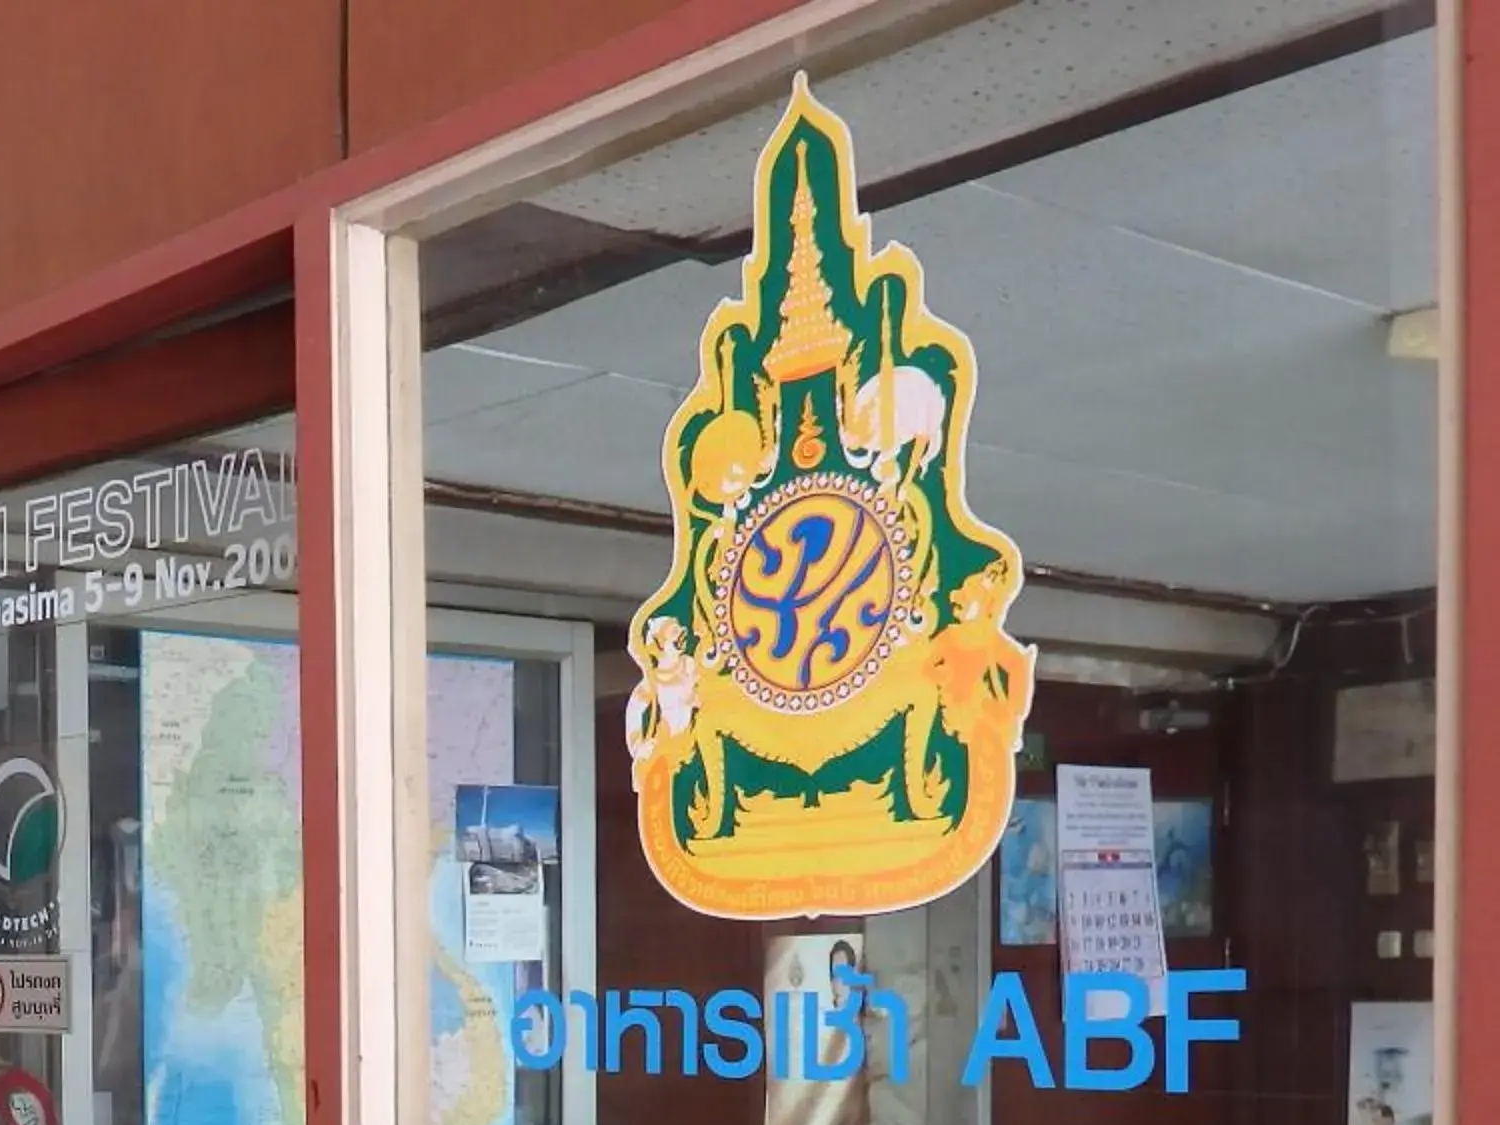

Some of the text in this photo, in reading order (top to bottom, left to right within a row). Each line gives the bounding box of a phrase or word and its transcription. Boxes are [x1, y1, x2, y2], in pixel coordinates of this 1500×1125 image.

[84, 564, 143, 613] 5-9
[510, 964, 1247, 1093] อาหารเช้า ABF
